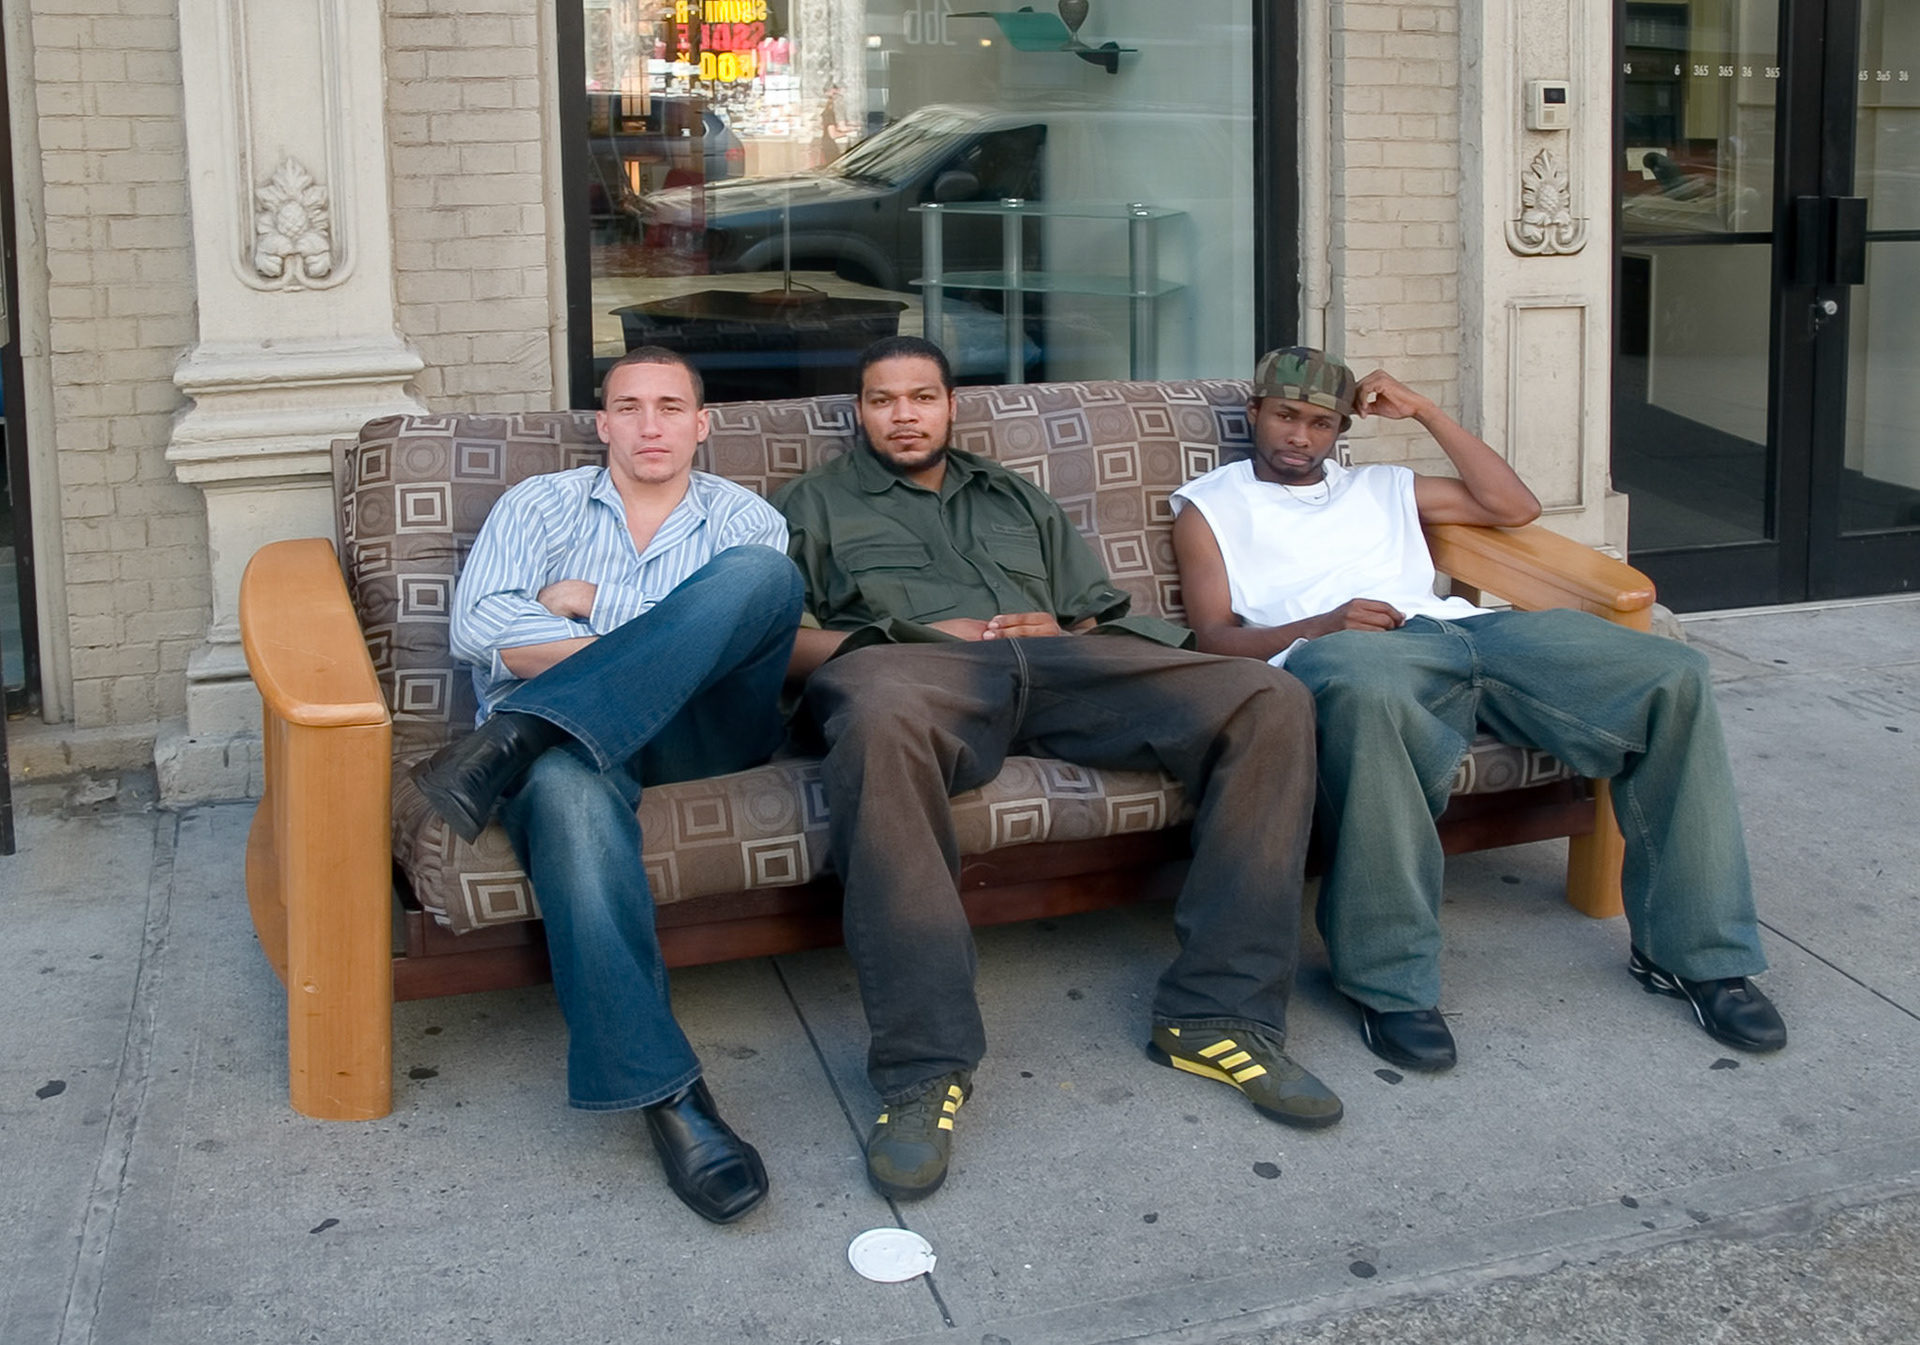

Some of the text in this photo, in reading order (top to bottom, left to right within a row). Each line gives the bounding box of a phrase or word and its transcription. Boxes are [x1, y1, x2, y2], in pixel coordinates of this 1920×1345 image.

[1693, 65, 1709, 77] 365
[1718, 66, 1734, 77] 365
[1765, 67, 1780, 78] 365
